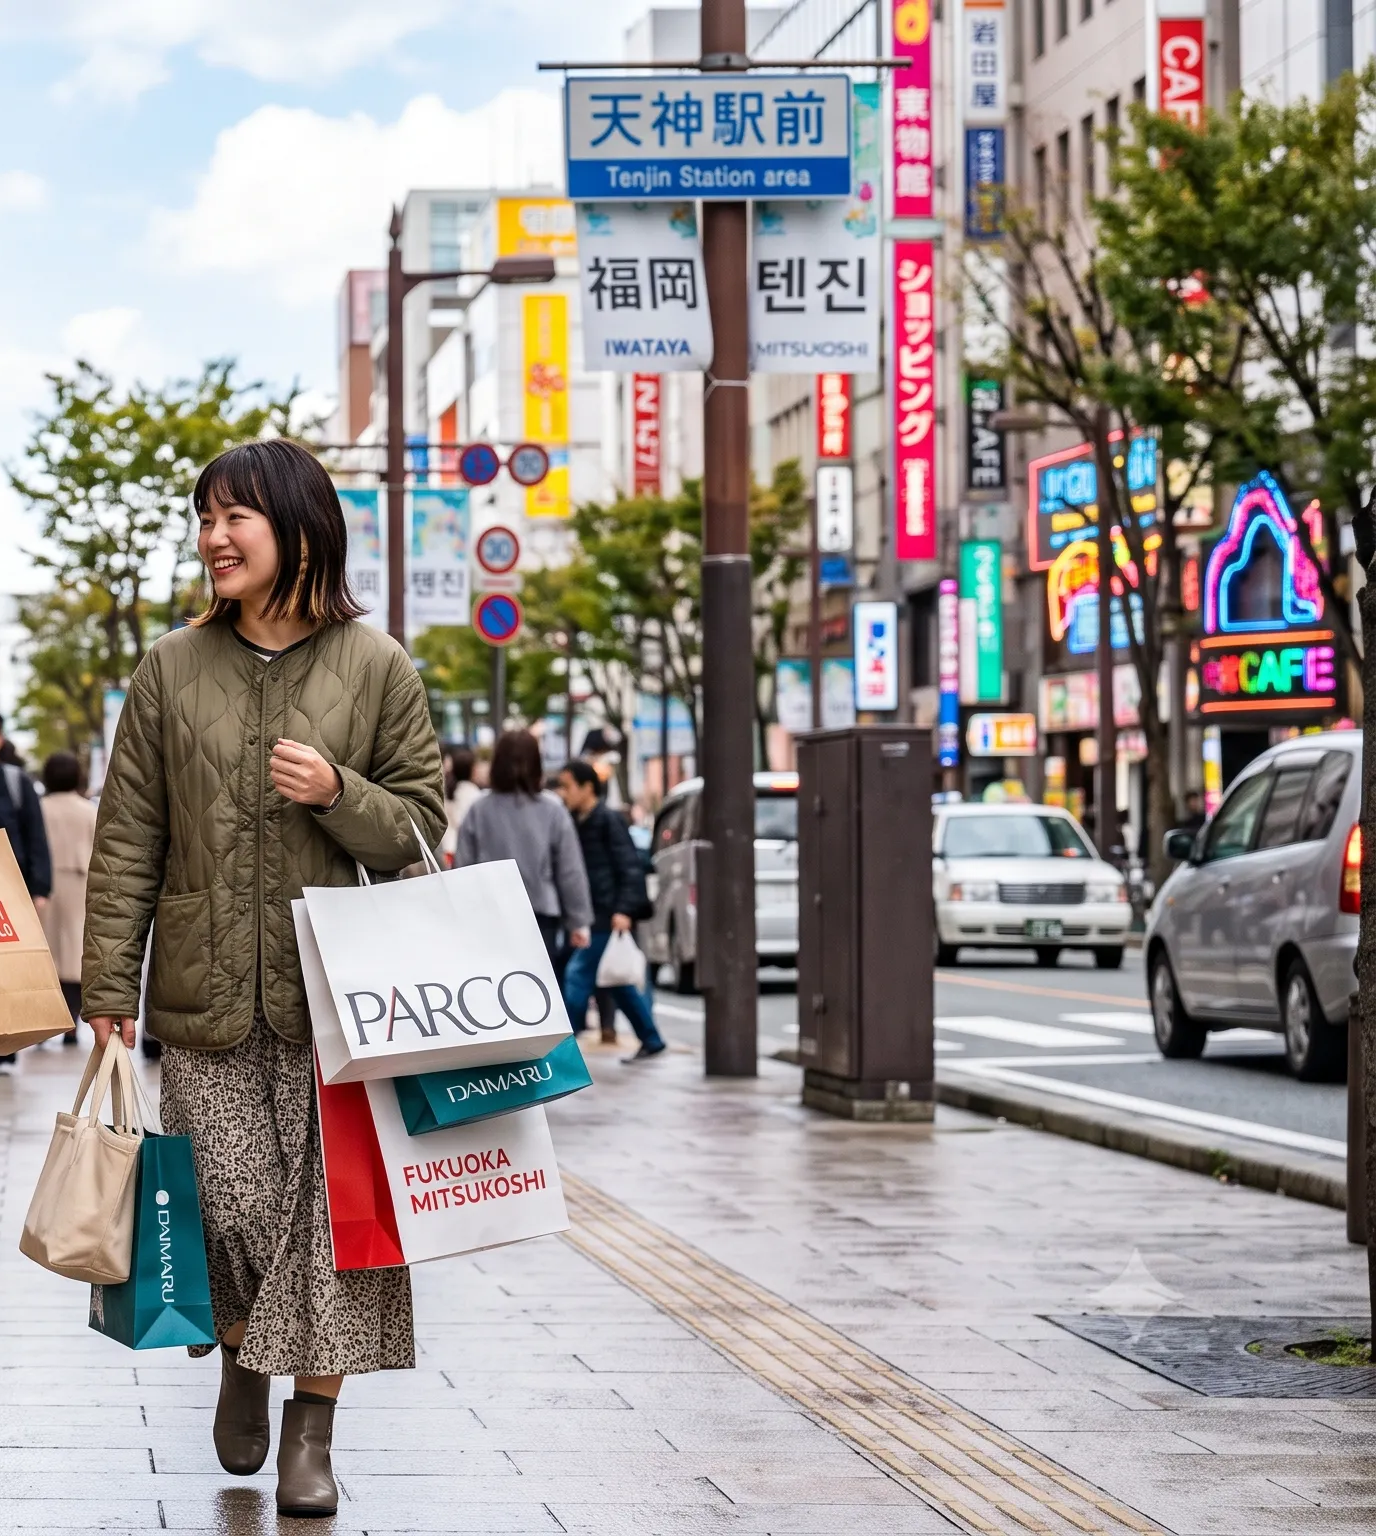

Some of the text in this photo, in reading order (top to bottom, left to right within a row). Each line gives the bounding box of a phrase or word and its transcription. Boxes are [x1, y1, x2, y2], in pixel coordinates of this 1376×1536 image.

[1162, 35, 1201, 127] CAF
[589, 91, 827, 148] 天神駅前
[606, 164, 812, 193] Tenjin Station area
[587, 256, 699, 311] 福岡
[757, 257, 866, 313] 텐진
[604, 338, 692, 357] IWATAYA
[343, 970, 552, 1046] PARCO
[446, 1062, 553, 1103] DAIMARU
[402, 1148, 512, 1188] FUKUOKA
[410, 1169, 547, 1215] MITSUKOSHI
[157, 1209, 175, 1304] DAIMARU
